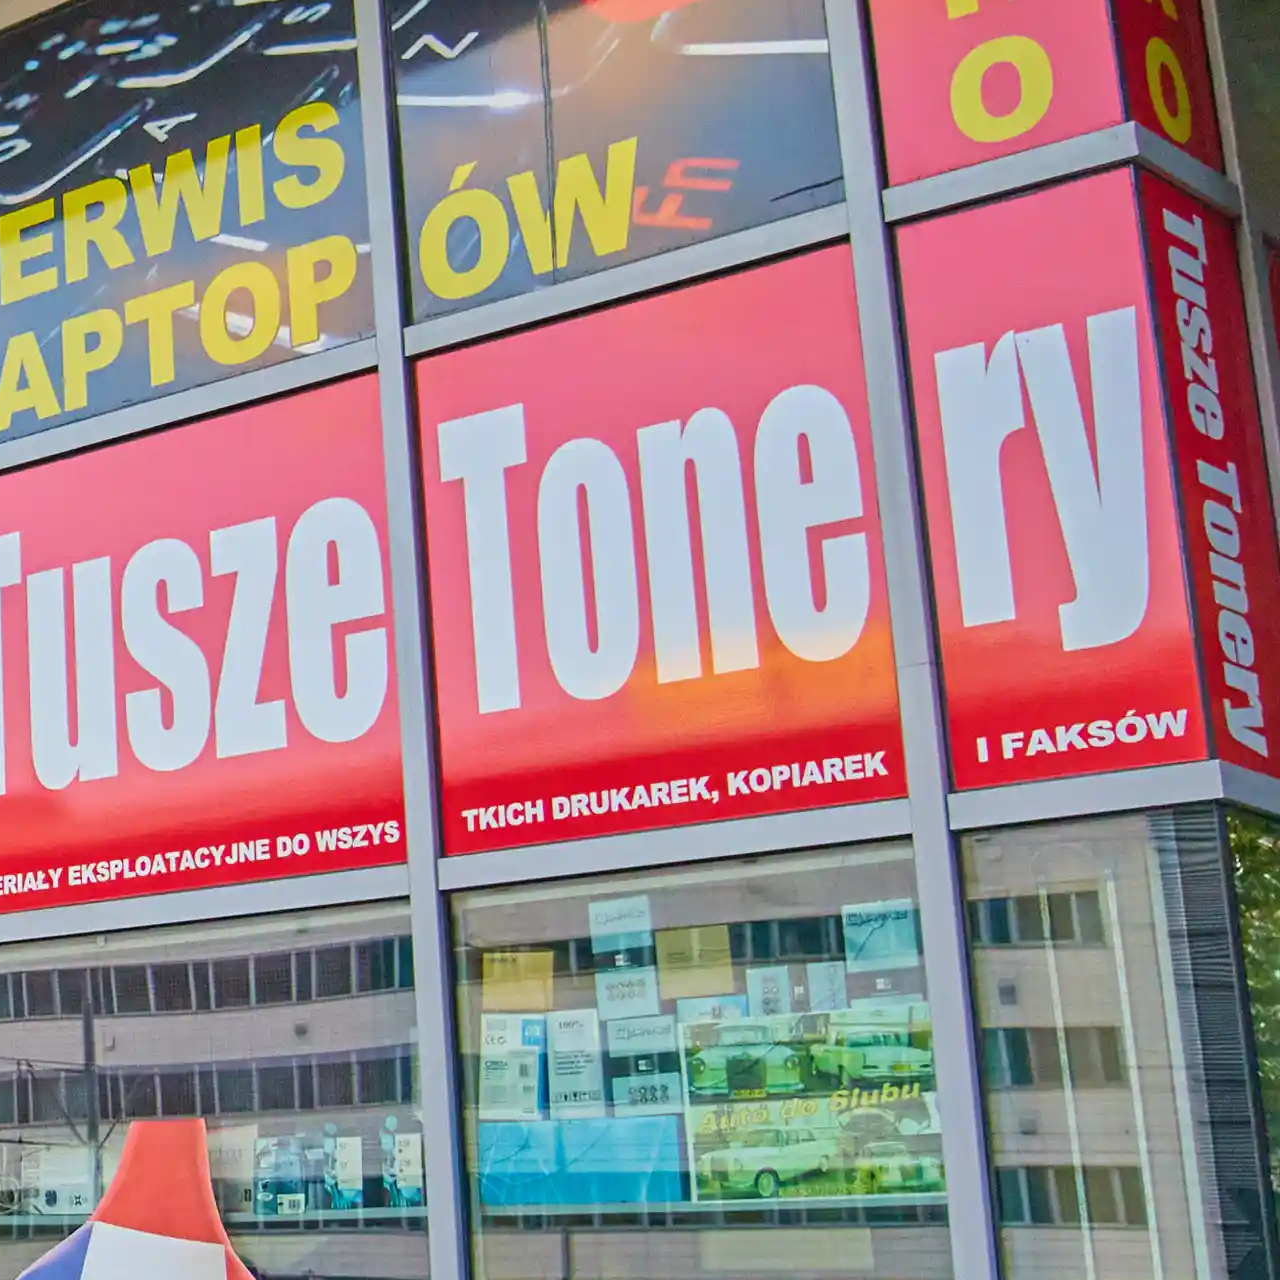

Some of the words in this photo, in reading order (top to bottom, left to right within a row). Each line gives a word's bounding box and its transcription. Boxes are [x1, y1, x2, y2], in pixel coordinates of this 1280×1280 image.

[1162, 206, 1225, 442] Tusze
[1195, 461, 1268, 757] Tonery
[67, 840, 270, 886] EKSPLOATACYJNE
[276, 834, 310, 857] DO
[314, 821, 400, 852] WSZYS
[462, 799, 544, 832] TKICH
[551, 775, 720, 822] DRUKAREK,
[726, 750, 889, 795] KOPIAREK
[976, 738, 989, 763] I
[1002, 709, 1188, 760] FAKSÓW
[697, 1107, 769, 1134] Auto
[780, 1097, 819, 1121] do
